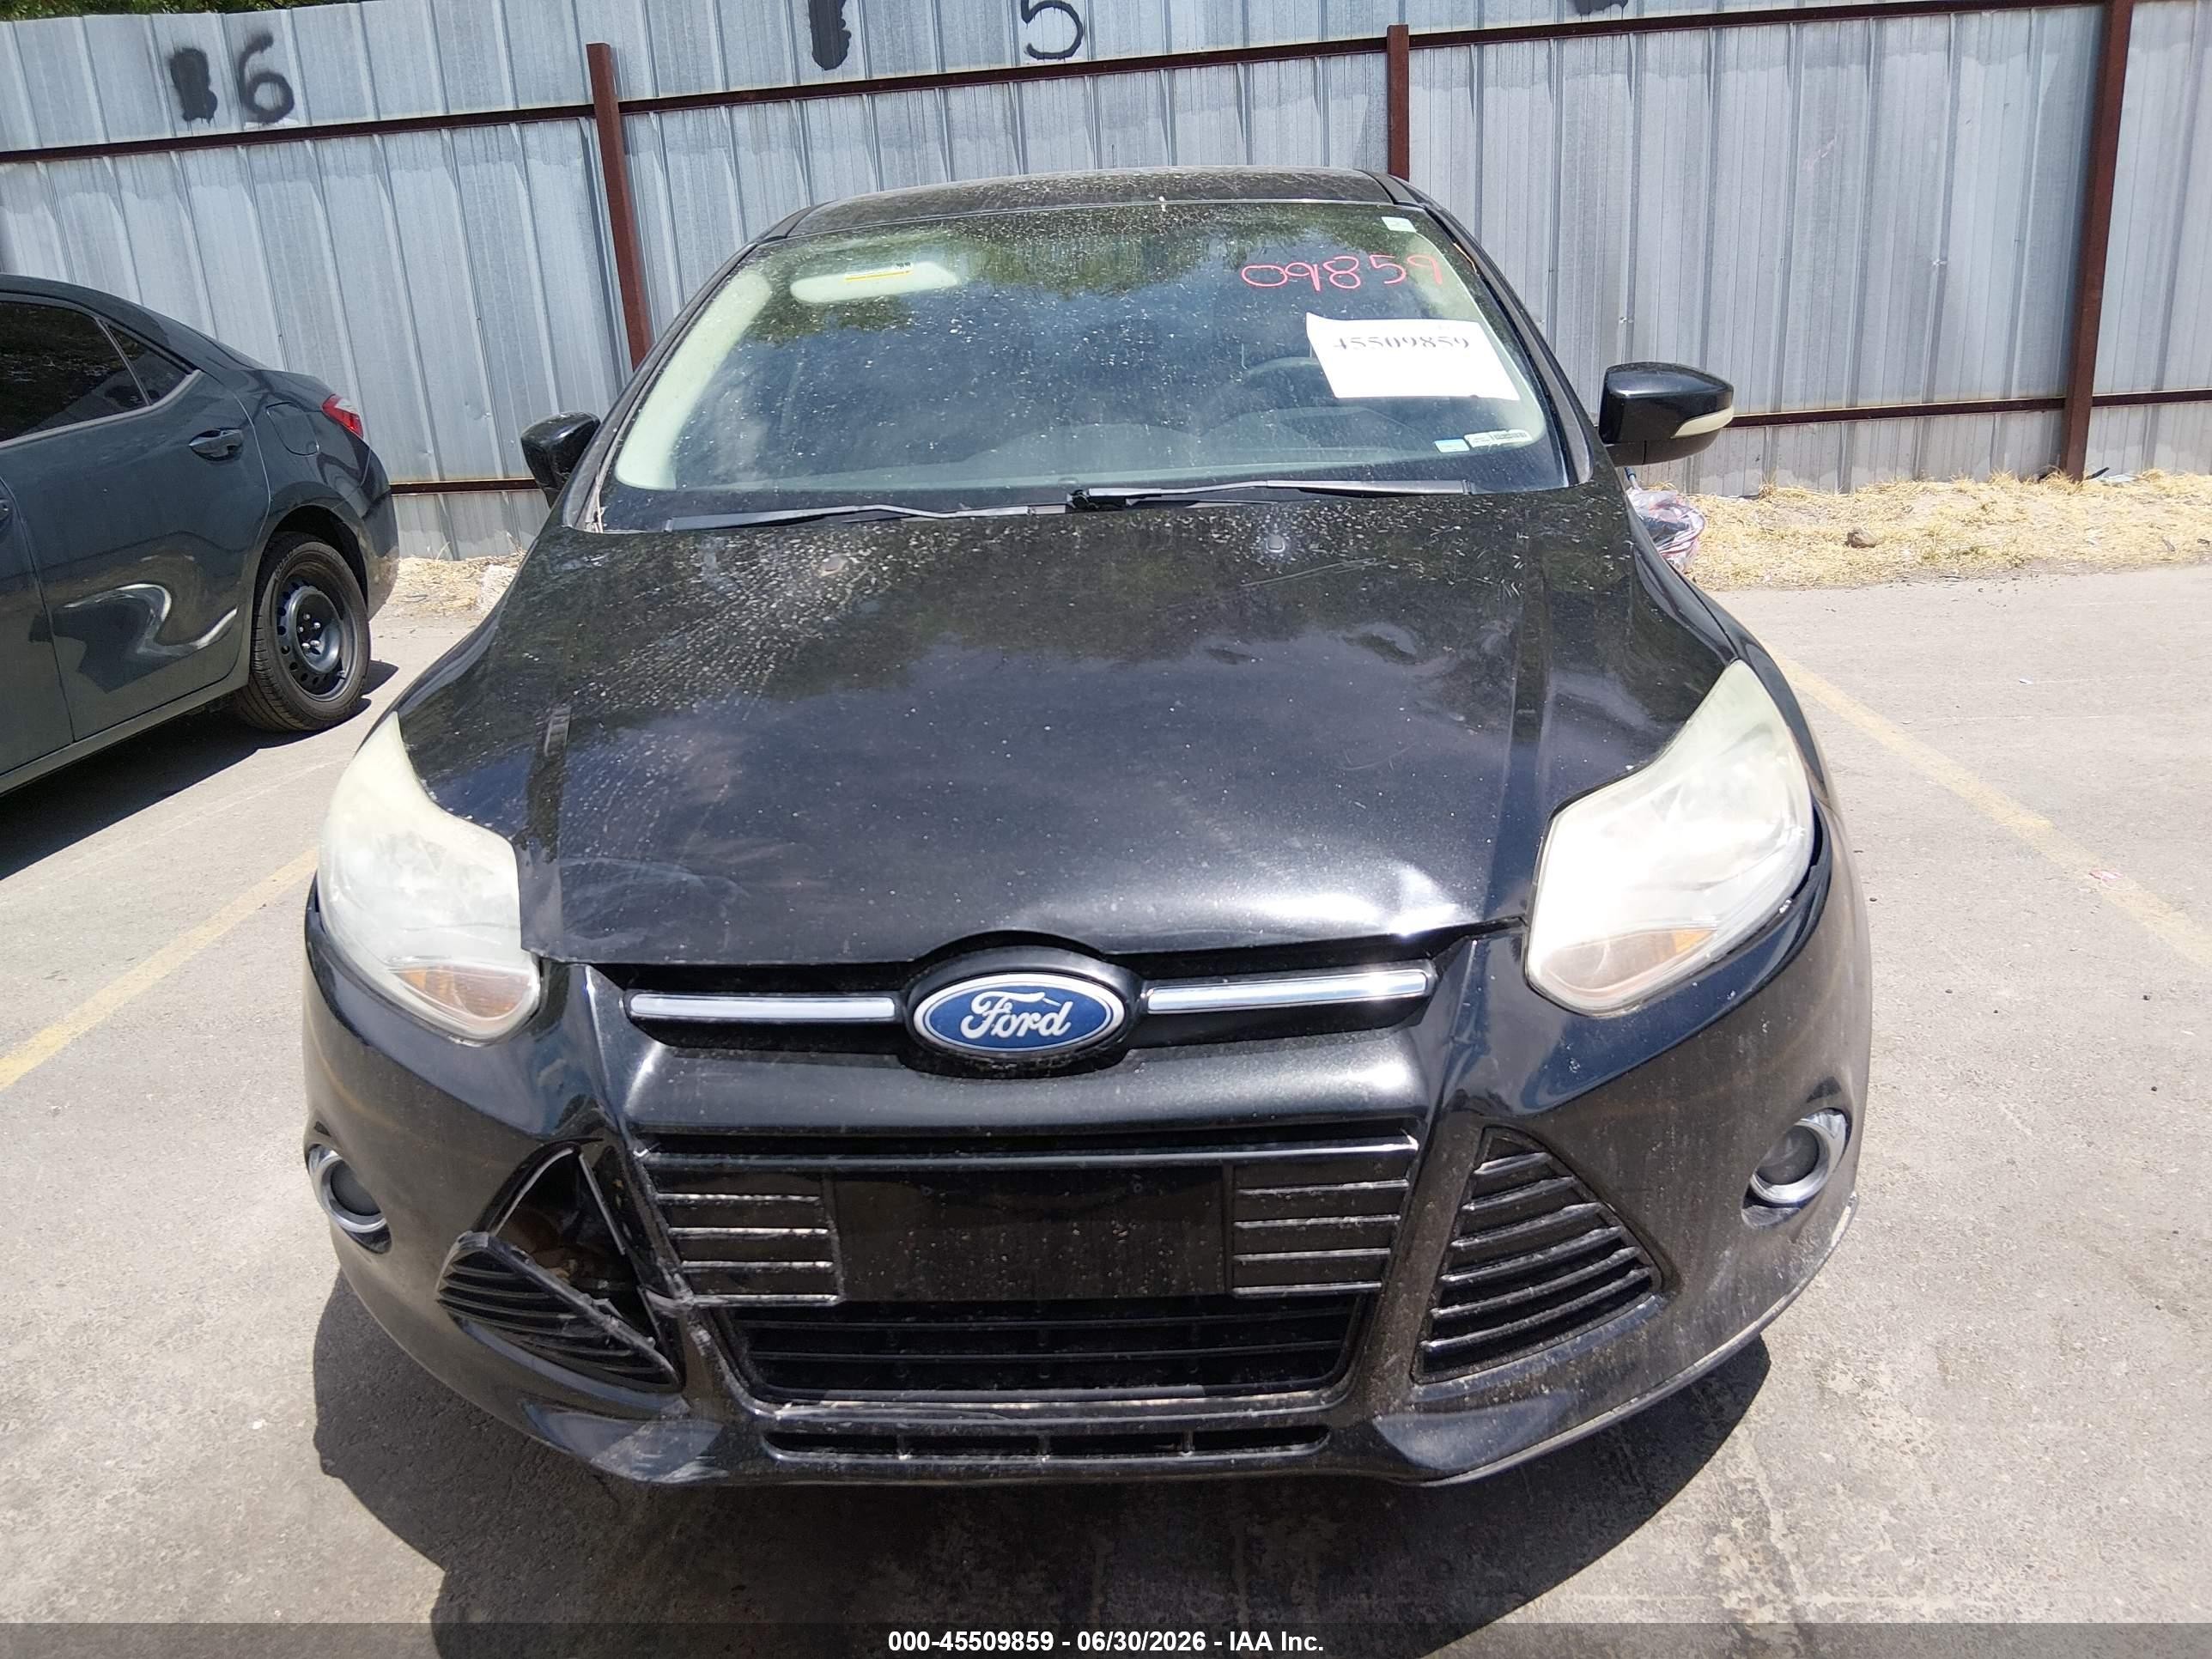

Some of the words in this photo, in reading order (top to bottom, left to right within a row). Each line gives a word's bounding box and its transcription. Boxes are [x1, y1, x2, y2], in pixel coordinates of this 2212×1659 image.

[236, 33, 295, 125] 6
[1241, 254, 1443, 292] 09859
[960, 991, 1073, 1039] Ford
